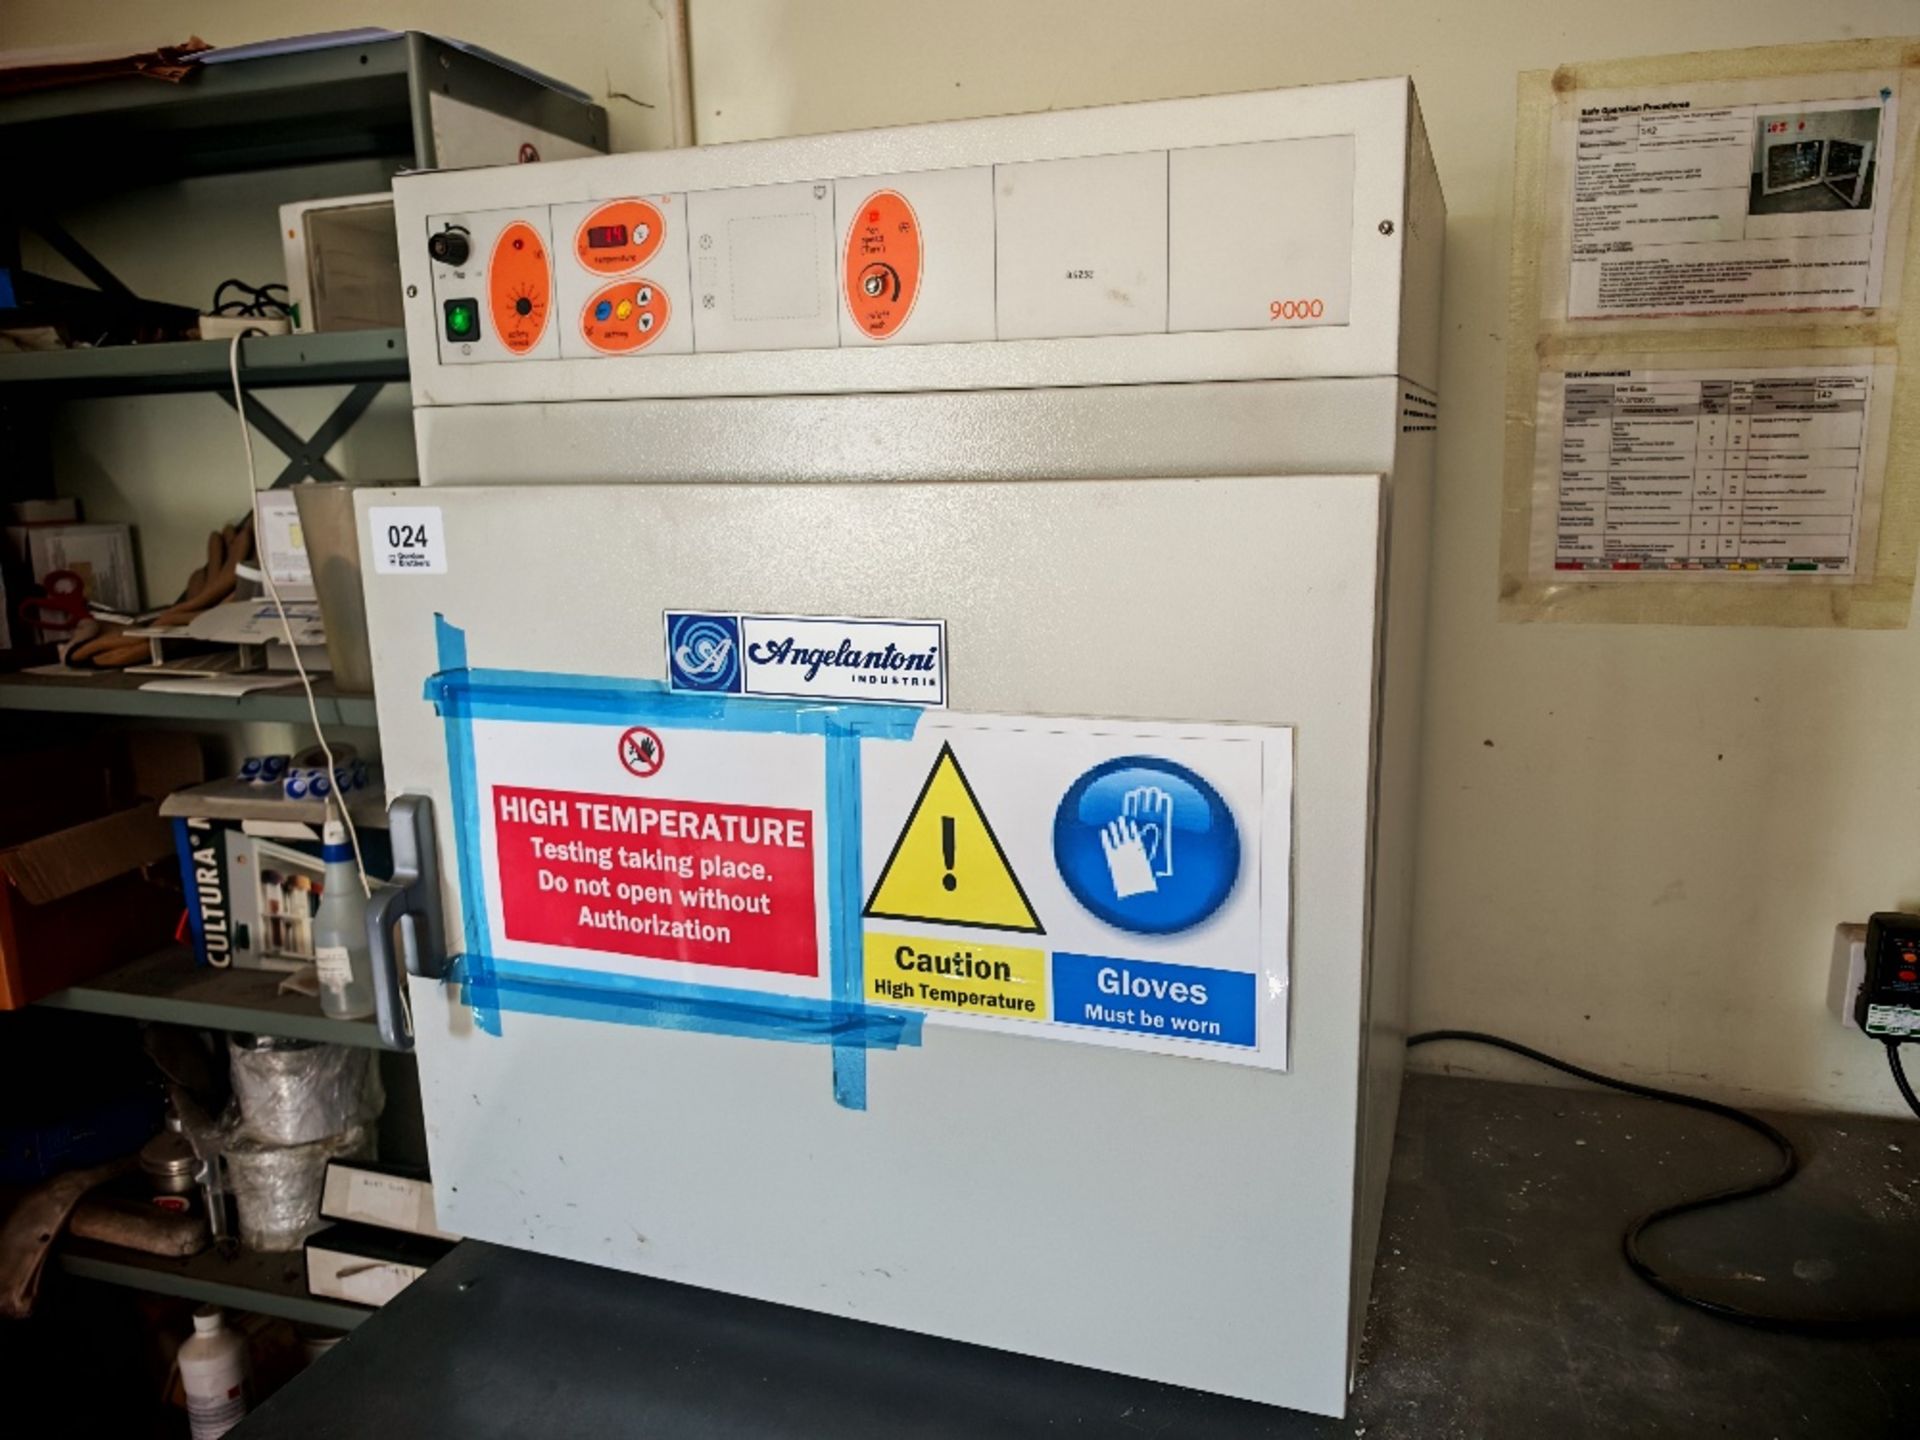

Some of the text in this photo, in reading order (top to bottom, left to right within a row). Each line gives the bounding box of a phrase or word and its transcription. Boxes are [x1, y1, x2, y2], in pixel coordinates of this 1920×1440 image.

[1269, 299, 1324, 321] 9000
[388, 525, 428, 548] 024
[749, 636, 938, 682] Angelantoni
[851, 674, 937, 687] INDUSTRIE
[500, 795, 806, 849] HIGH TEMPERATURE
[530, 837, 773, 882] Testing taking place.
[538, 869, 771, 916] Do not open without
[578, 905, 732, 943] Authorization
[895, 945, 1012, 983] Caution
[874, 979, 1036, 1013] High Temperature
[1097, 966, 1209, 1006] Gloves
[1084, 1003, 1221, 1036] Must be worn
